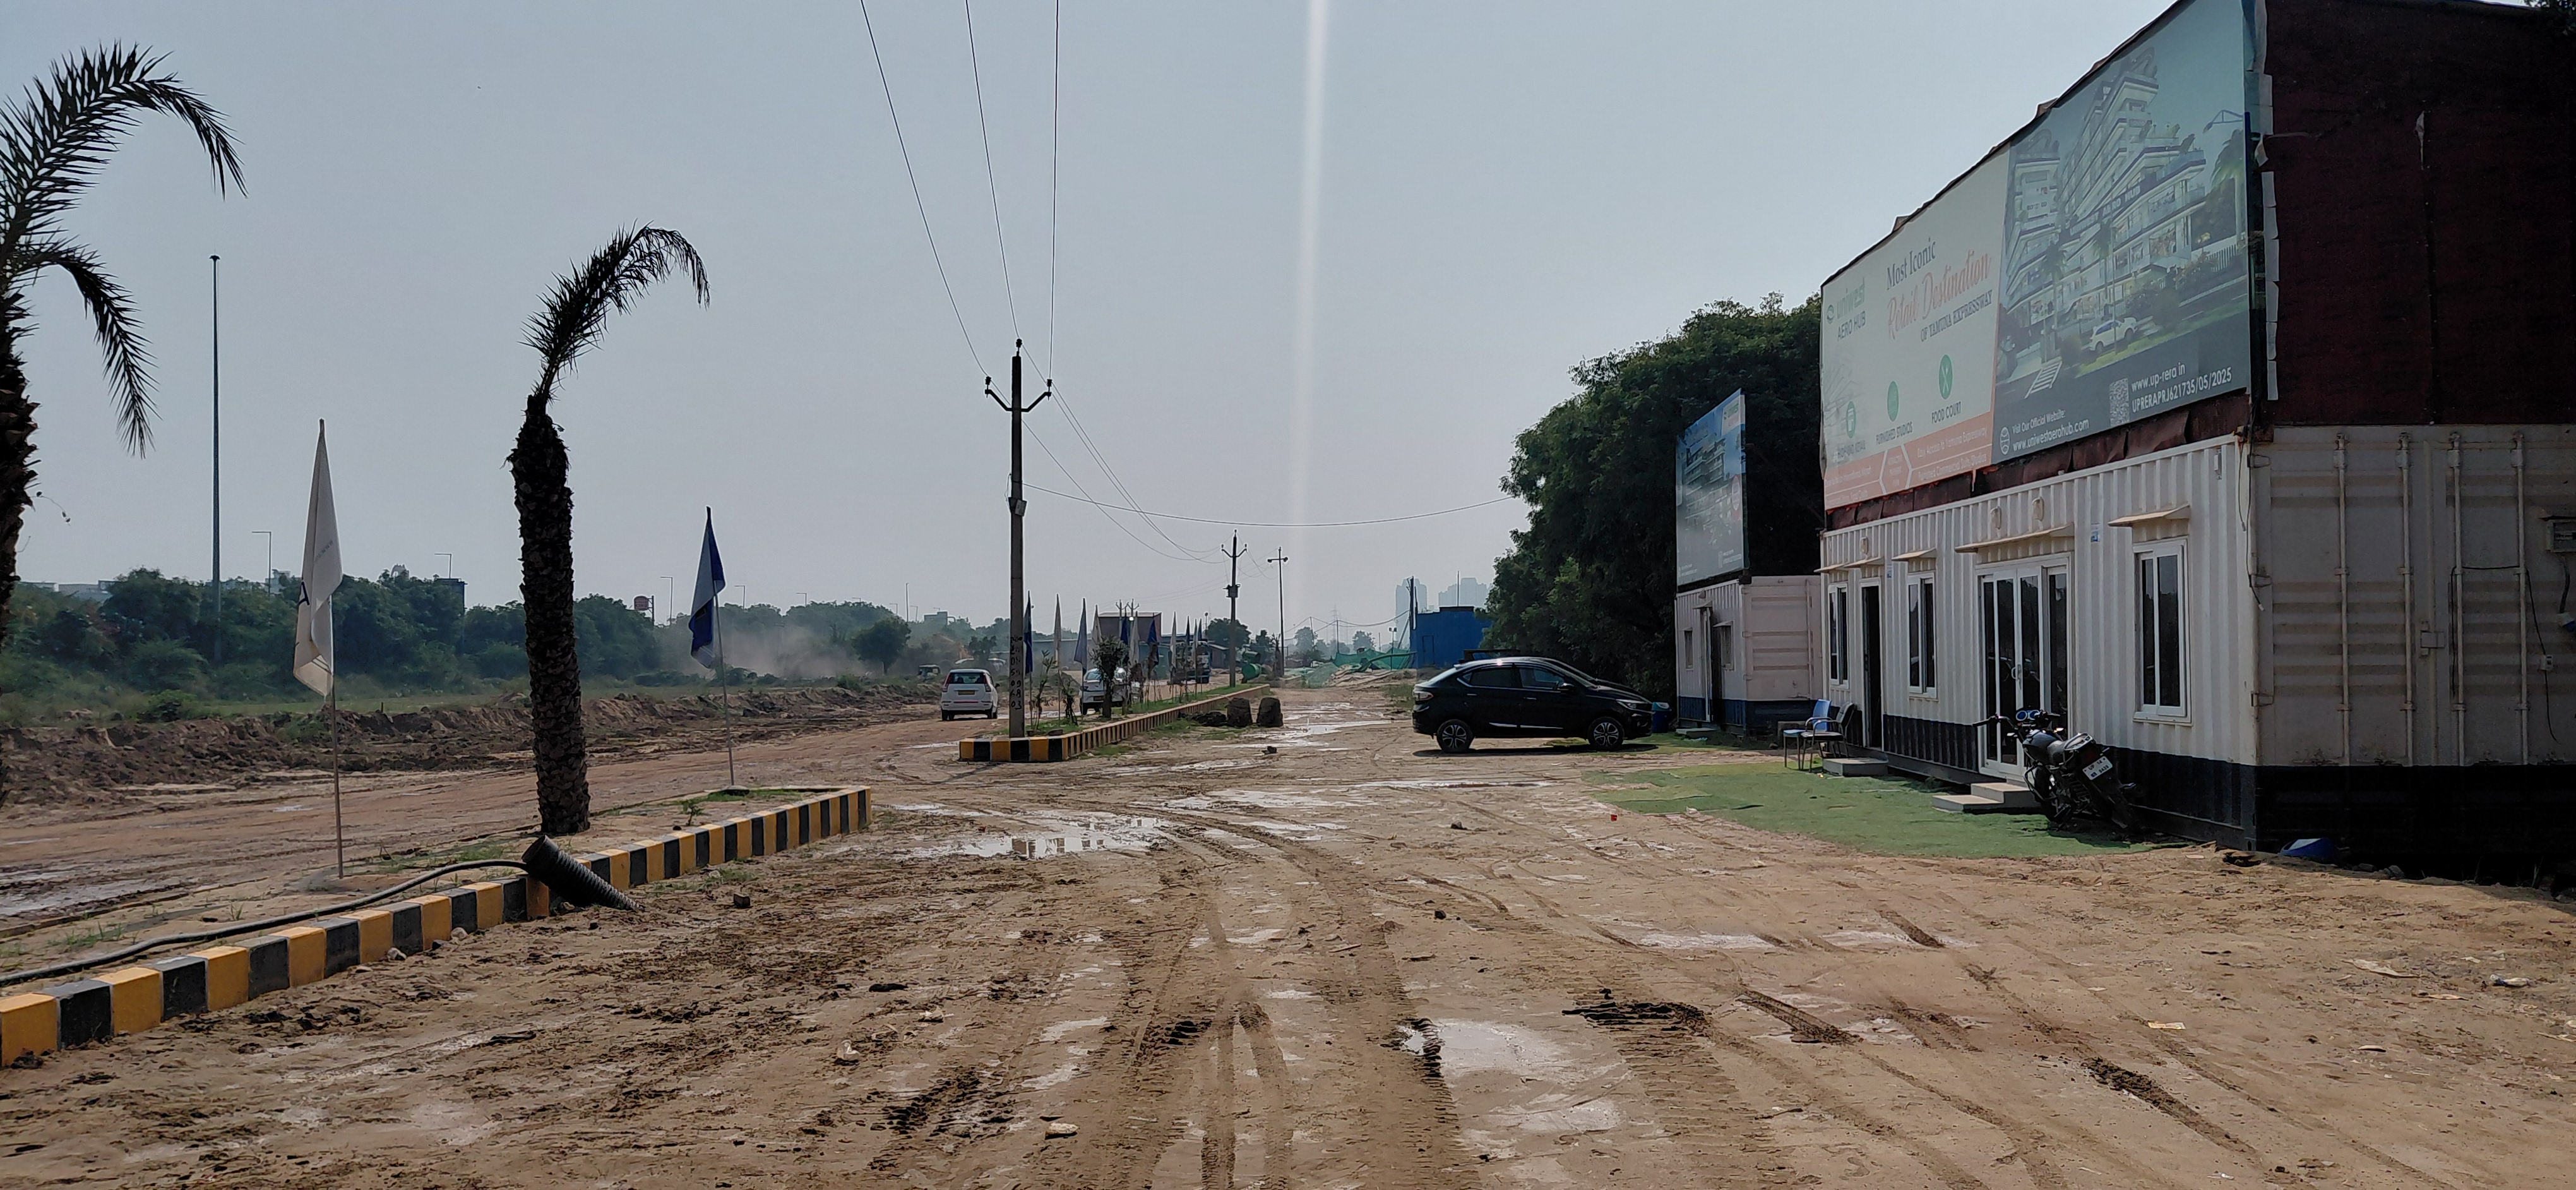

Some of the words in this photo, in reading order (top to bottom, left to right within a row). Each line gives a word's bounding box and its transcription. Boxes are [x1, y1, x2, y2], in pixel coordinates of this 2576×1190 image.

[1887, 258, 1907, 291] Most
[1909, 237, 1936, 275] Iconic
[1887, 285, 1921, 340] Retail
[1923, 249, 1993, 320] Destination
[1837, 319, 1853, 342] AERO
[1921, 327, 1928, 342] OF
[1953, 289, 1993, 324] EXPRESSWAY
[2132, 366, 2233, 414] UPRERAPRJ621735/05/2025
[1931, 407, 1945, 424] FOOD
[2012, 418, 2090, 452] www.uniwestaerohub.com
[2021, 420, 2030, 433] Our
[2030, 414, 2046, 429] Official
